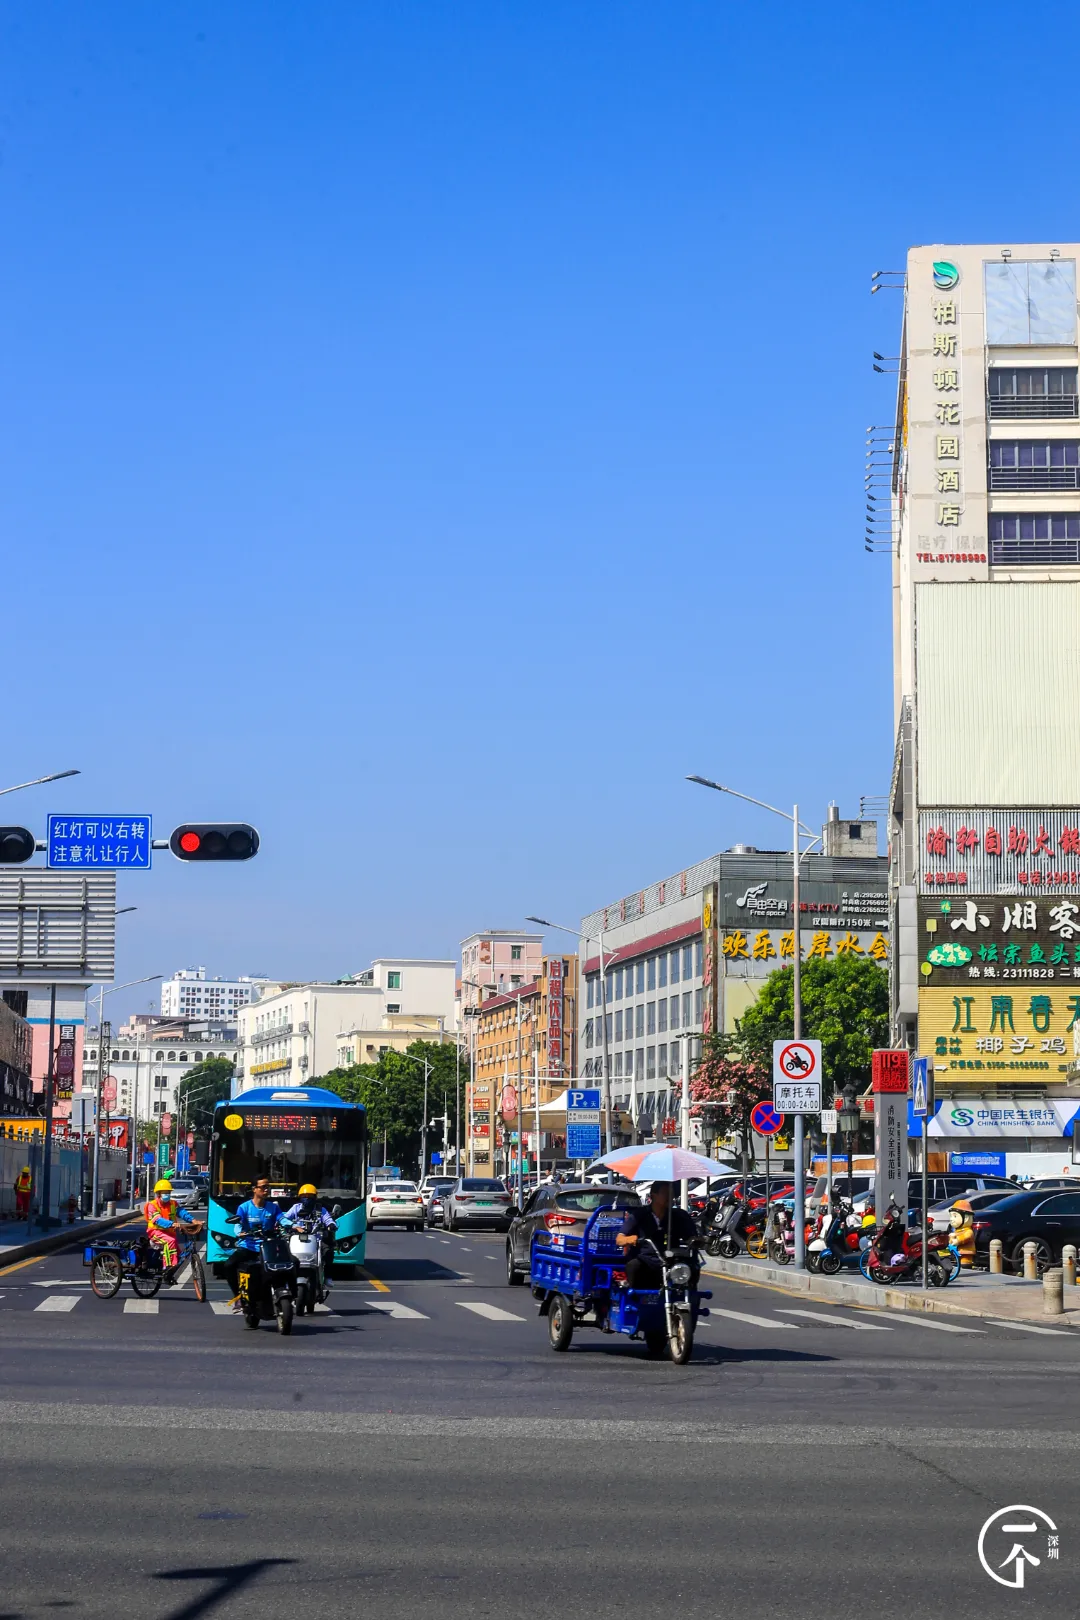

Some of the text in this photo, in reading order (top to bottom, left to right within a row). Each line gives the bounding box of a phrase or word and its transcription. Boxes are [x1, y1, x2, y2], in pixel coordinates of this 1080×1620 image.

[932, 300, 961, 528] 柏斯顿花园酒店
[54, 821, 146, 840] 红灯可以右转
[53, 844, 145, 863] 注意礼让行人
[950, 900, 1080, 939] 小湘客
[722, 930, 890, 960] 欢乐海岸水会
[548, 959, 562, 1077] 启程优品酒店
[976, 1036, 1067, 1054] 椰子鸡
[571, 1092, 585, 1107] P
[780, 1086, 816, 1099] 摩托车
[777, 1100, 819, 1109] 00:00-24:00
[977, 1109, 1056, 1121] 中国民生银行
[887, 1104, 896, 1180] 消防安全示范街
